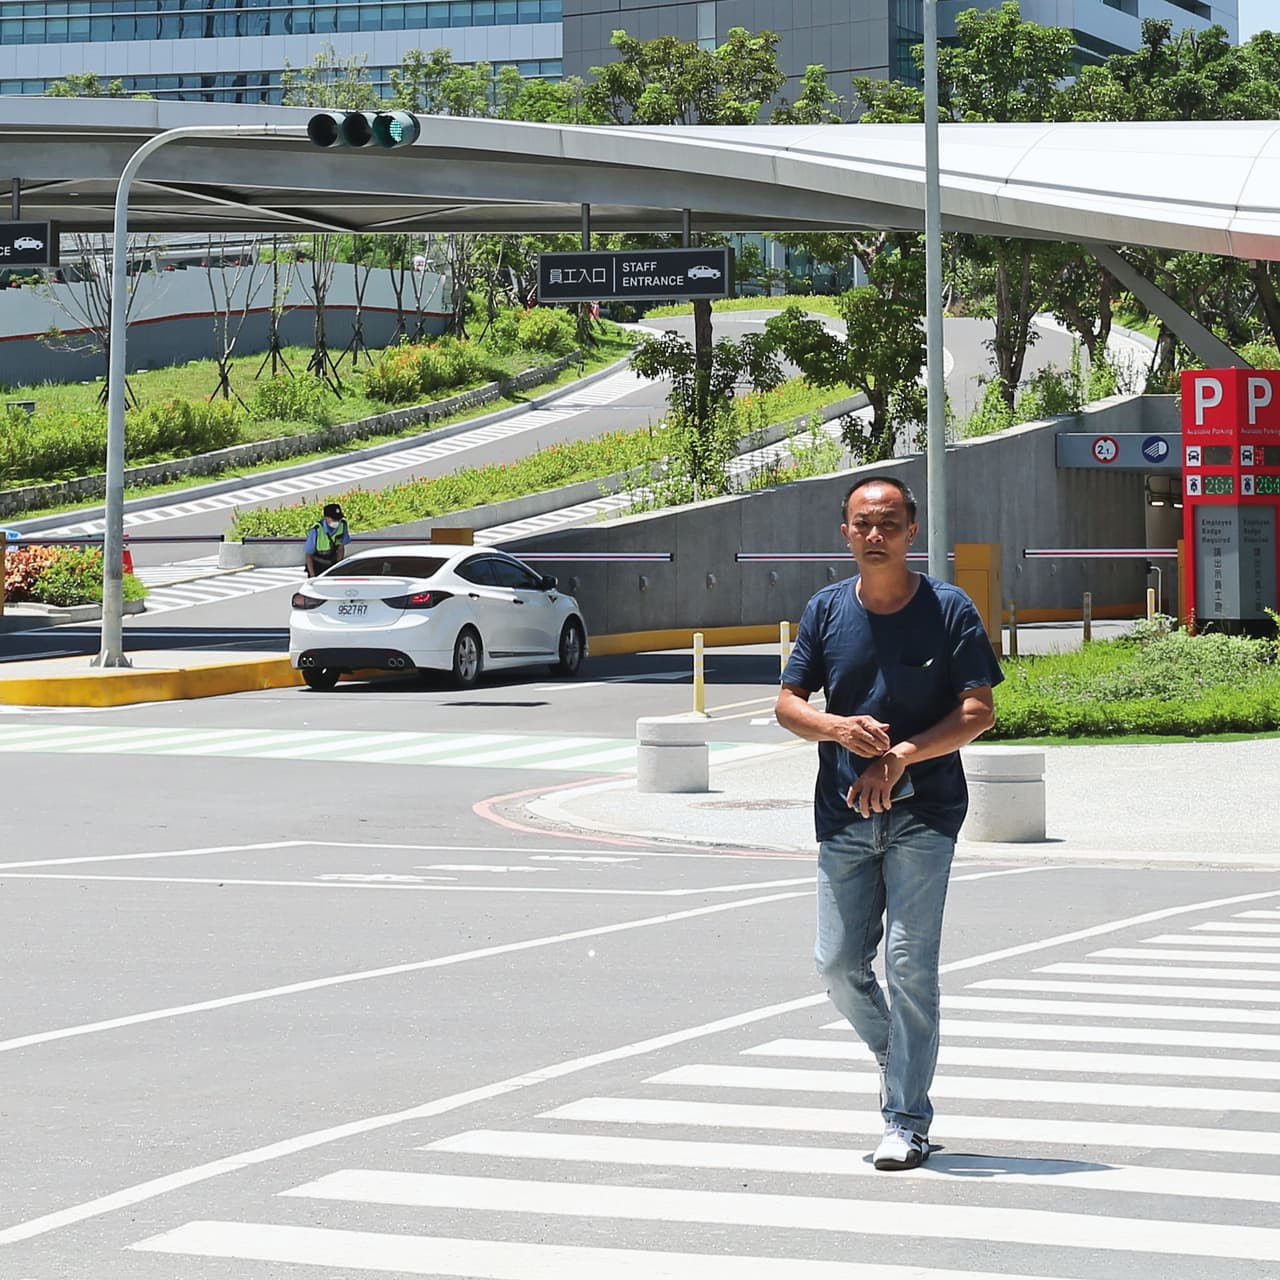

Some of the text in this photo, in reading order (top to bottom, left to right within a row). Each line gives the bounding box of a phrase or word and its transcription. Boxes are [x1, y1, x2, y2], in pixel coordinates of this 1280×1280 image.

[622, 261, 657, 273] STAFF
[549, 268, 606, 284] 員工入口
[622, 275, 684, 287] ENTRANCE
[1194, 377, 1223, 425] P
[1248, 377, 1273, 425] P
[1212, 427, 1233, 436] Parking
